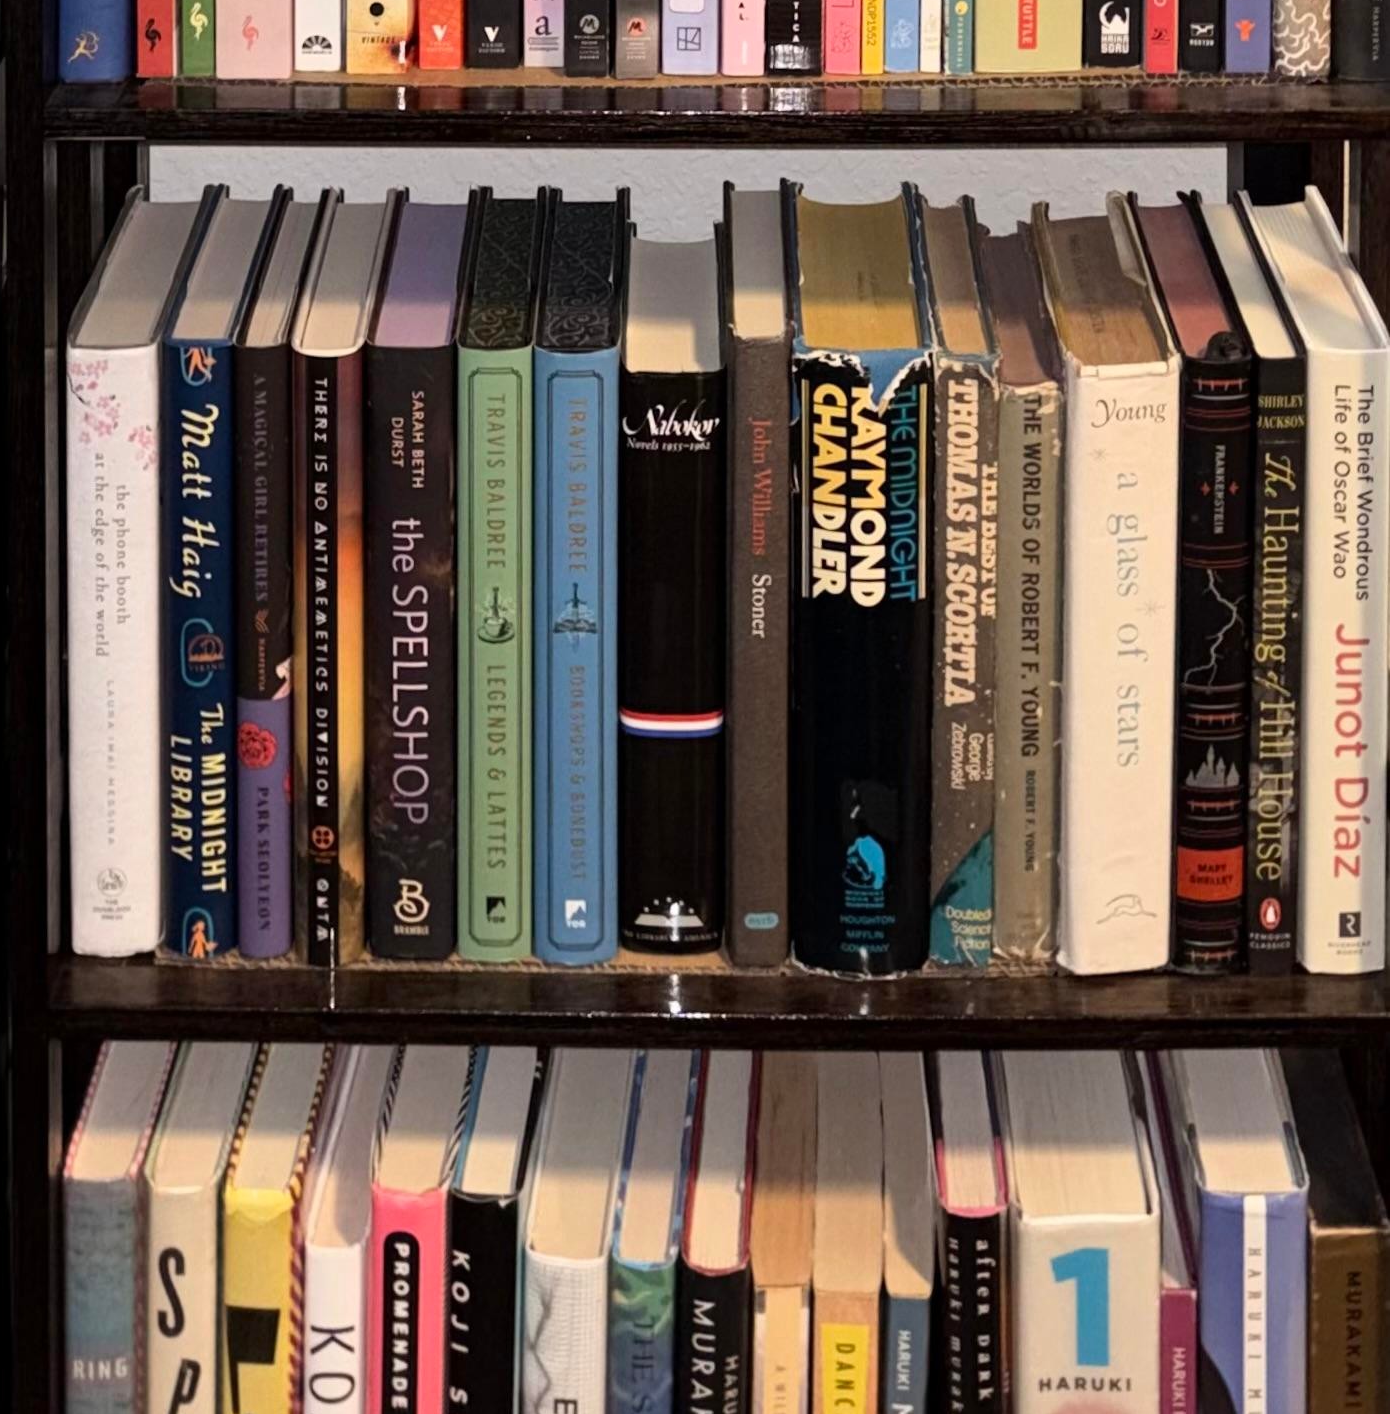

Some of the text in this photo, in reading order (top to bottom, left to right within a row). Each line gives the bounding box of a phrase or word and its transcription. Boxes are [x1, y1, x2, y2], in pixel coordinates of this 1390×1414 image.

[1024, 396, 1040, 432] THE
[172, 404, 215, 598] Matt Haig
[814, 383, 846, 598] CHANDLER
[1024, 439, 1040, 526] WORLDS
[1024, 534, 1039, 563] OF
[752, 575, 771, 637] Stoner
[1022, 569, 1039, 655] ROBERT
[392, 519, 429, 825] the SPELLSHOP
[1022, 686, 1039, 756] YOUNG
[1335, 626, 1370, 877] Junot Díaz
[170, 736, 192, 860] LIBRARY
[201, 704, 226, 892] The MIDNIGHT
[1050, 1248, 1110, 1366] 1
[73, 1360, 128, 1378] RING
[1038, 1378, 1132, 1391] HARUKI
